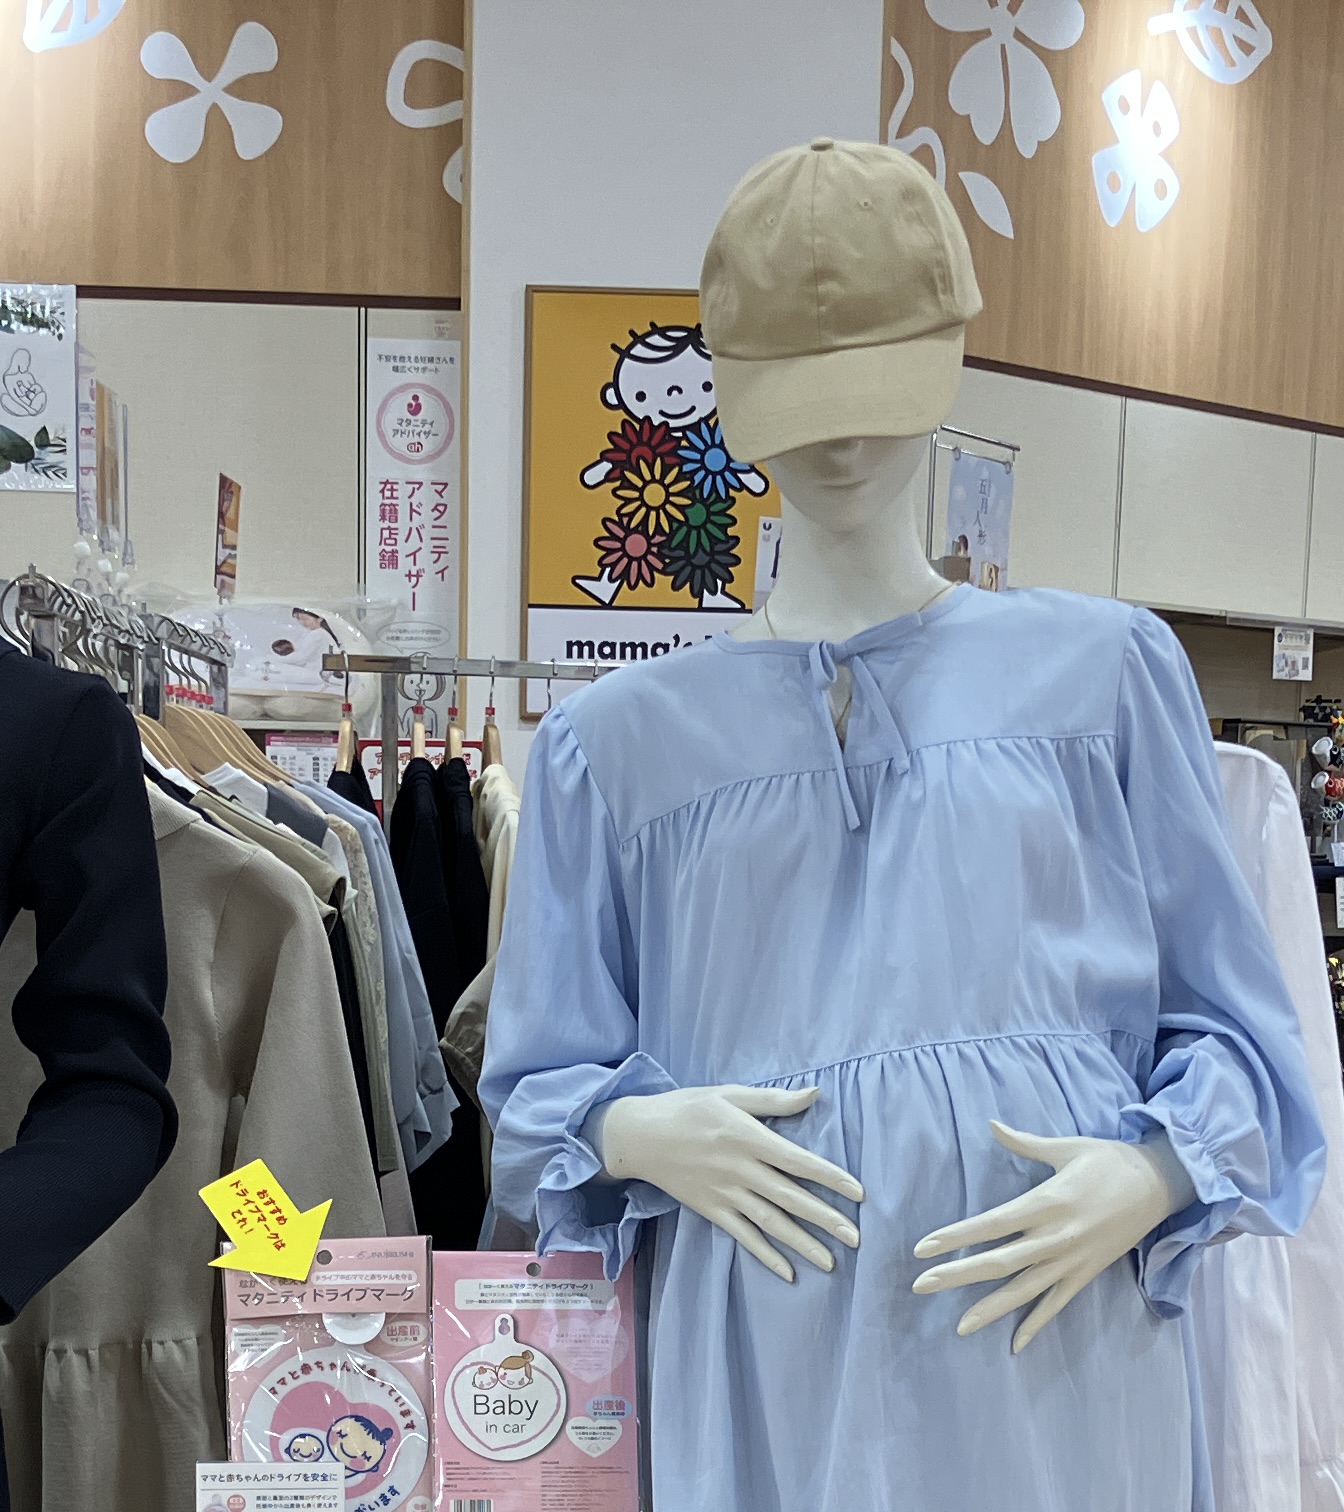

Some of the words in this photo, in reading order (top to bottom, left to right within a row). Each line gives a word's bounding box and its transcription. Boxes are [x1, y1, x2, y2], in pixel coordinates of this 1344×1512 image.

[396, 418, 435, 428] マタニティ
[391, 428, 439, 439] アドバイザー
[378, 478, 400, 571] 在籍店舗
[429, 480, 450, 582] マタニティ
[404, 480, 426, 612] アドバイザー
[256, 1189, 288, 1226] おすすめ
[385, 1325, 421, 1337] 出産前
[472, 1393, 540, 1421] Baby
[591, 1400, 627, 1412] 出産後
[484, 1421, 498, 1434] in
[502, 1423, 527, 1434] car
[199, 1472, 339, 1483] ママと赤ちゃんのドライブを安全に
